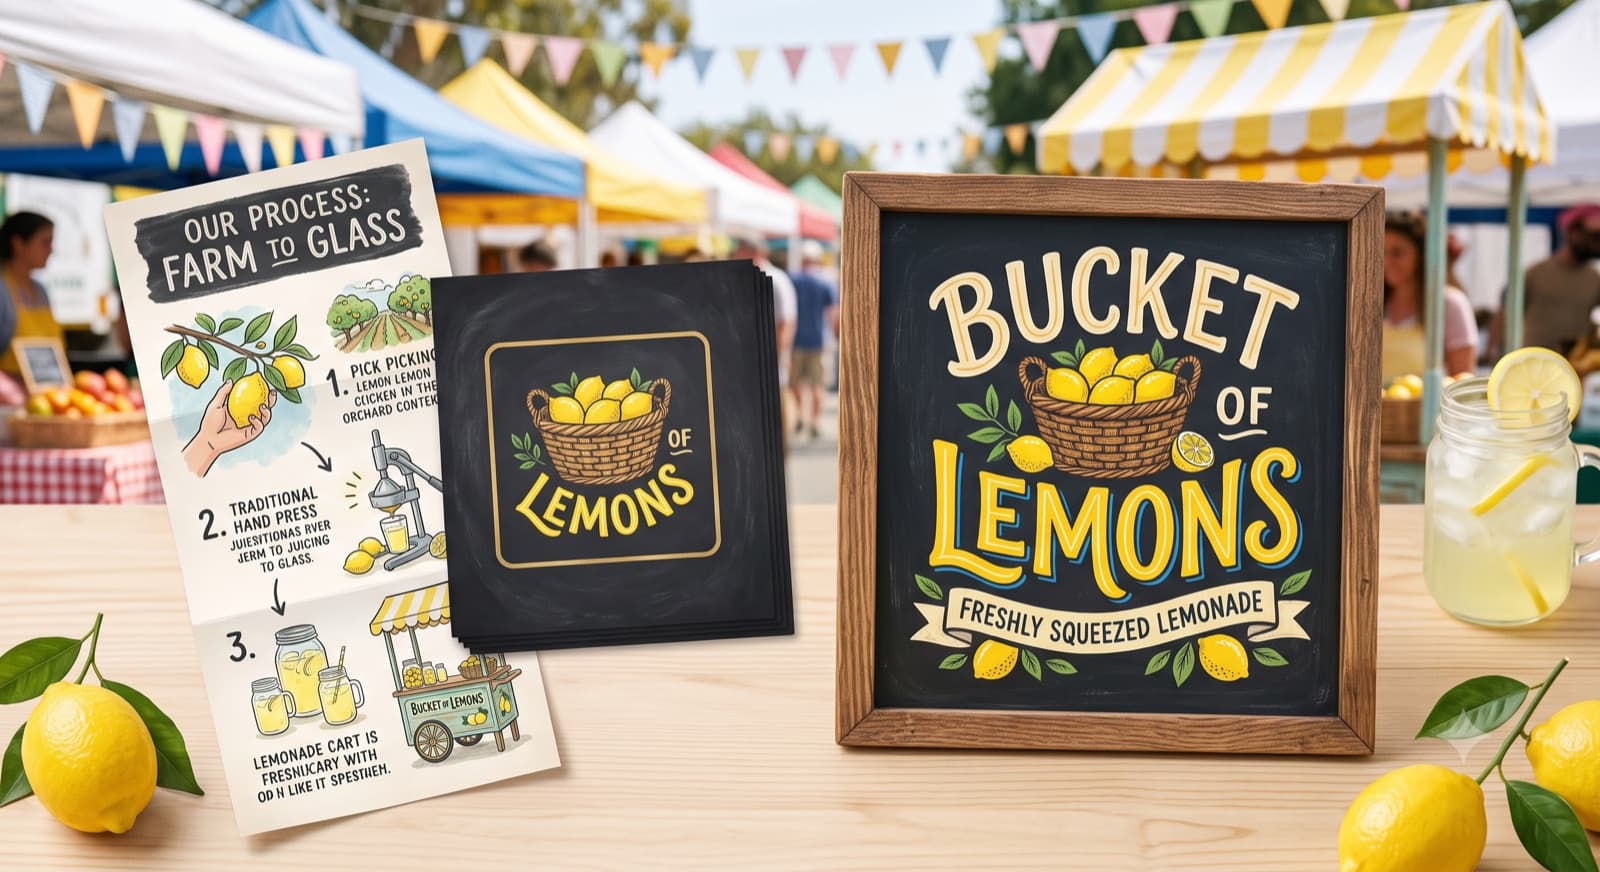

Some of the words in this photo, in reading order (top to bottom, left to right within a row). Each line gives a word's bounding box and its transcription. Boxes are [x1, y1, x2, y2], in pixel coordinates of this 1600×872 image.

[184, 211, 238, 244] OUR
[248, 184, 370, 231] PROCESS:
[162, 240, 258, 292] FARM
[266, 237, 296, 260] TO
[307, 209, 406, 258] GLASS
[928, 246, 1300, 378] BUCKET
[326, 368, 349, 397] 1.
[350, 360, 381, 379] PICK
[356, 376, 391, 393] LEMON
[395, 368, 431, 384] LEMON
[401, 385, 413, 397] IN
[416, 380, 437, 393] THE
[342, 404, 393, 424] ORCHARD
[1216, 386, 1273, 425] OF
[668, 428, 692, 448] OF
[229, 486, 319, 517] TRADITIONAL
[515, 463, 695, 538] LEMONS
[199, 508, 227, 541] 2.
[234, 514, 271, 534] HAND
[276, 504, 318, 525] PRESS
[928, 438, 1302, 603] LEMONS
[269, 544, 283, 556] TO
[288, 534, 330, 553] JUICING
[260, 561, 274, 573] TO
[278, 552, 314, 569] GLASS.
[960, 597, 1044, 639] FRESHLY
[1050, 617, 1150, 646] SQUEEZED
[1157, 590, 1263, 635] LEMONADE
[226, 631, 256, 663] 3.
[410, 700, 442, 716] BUCKET
[449, 693, 484, 710] LEMONS
[253, 742, 323, 770] LEMONADE
[328, 734, 361, 753] CART
[366, 730, 378, 744] IS
[344, 748, 378, 767] WITH
[288, 780, 313, 796] LIKE
[316, 777, 326, 790] IT
